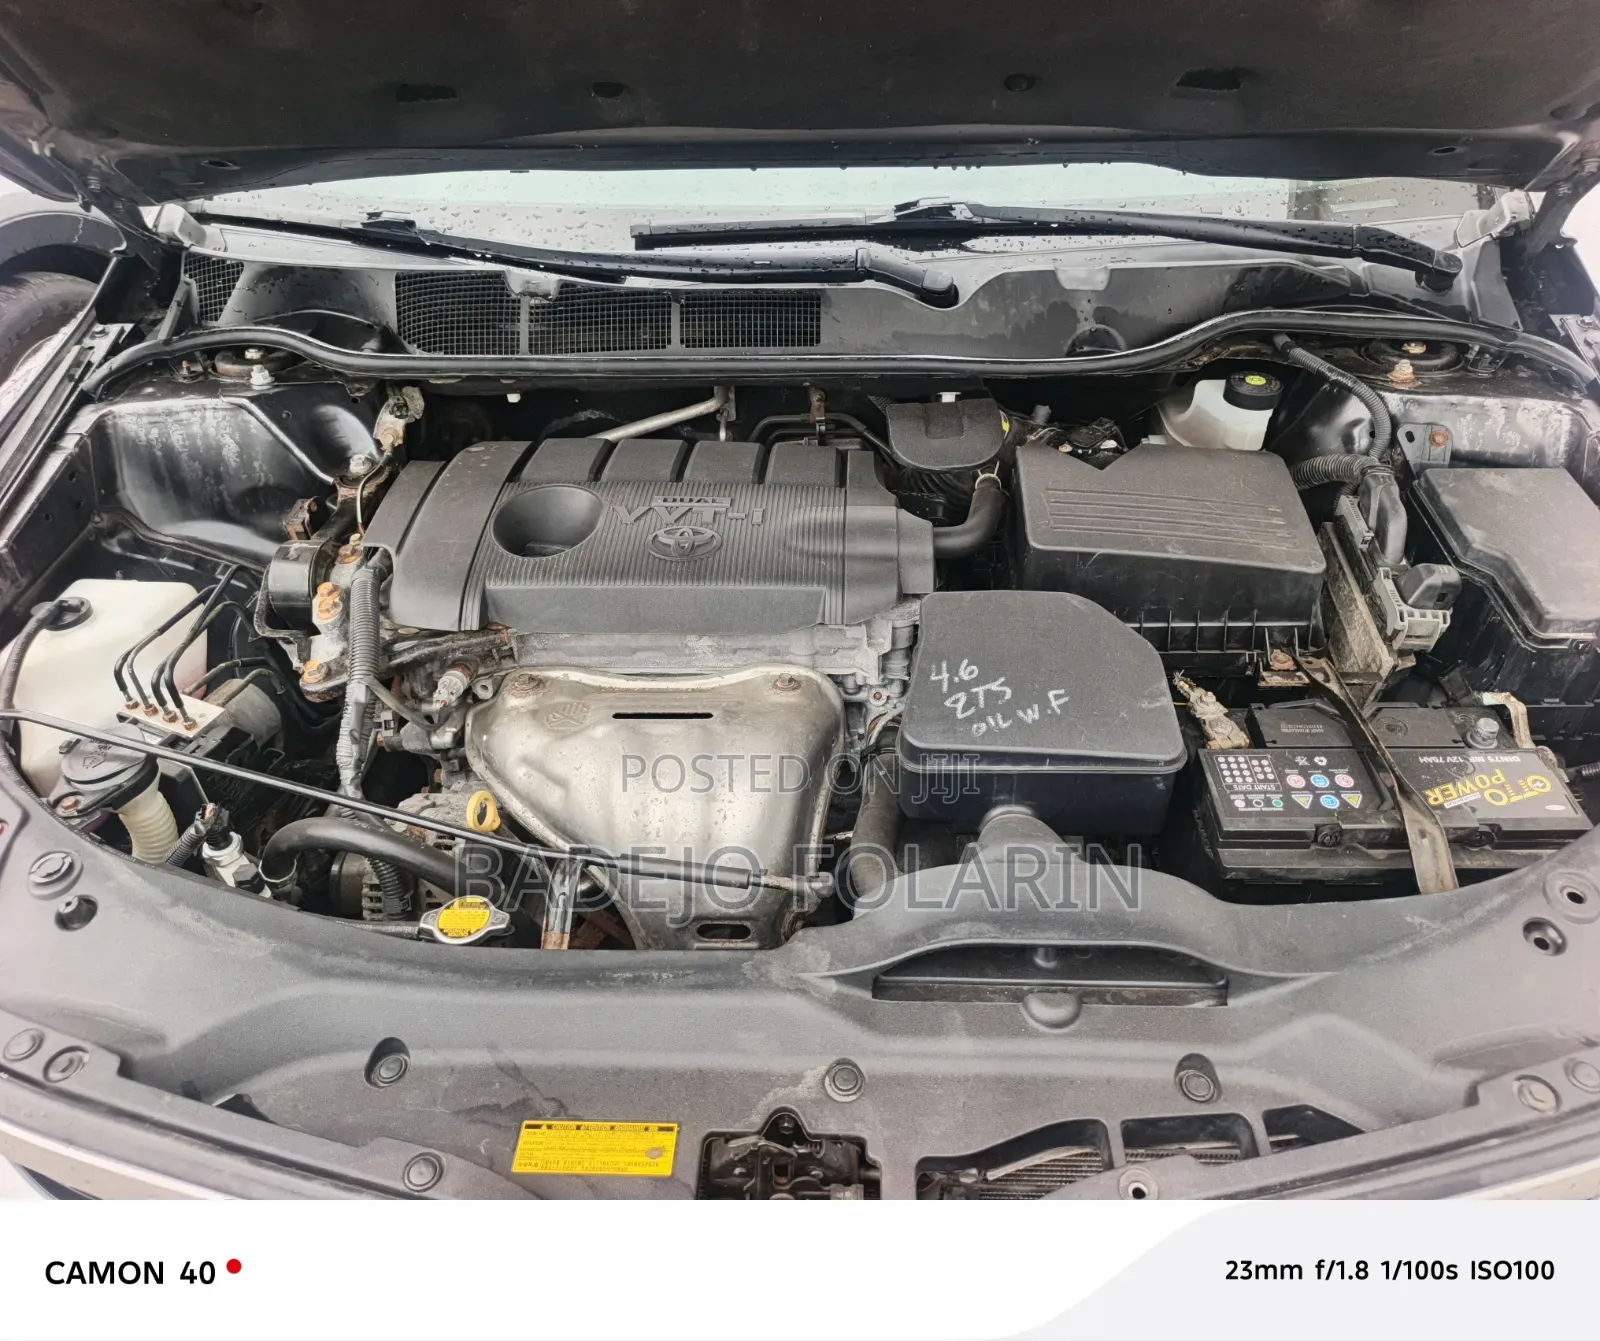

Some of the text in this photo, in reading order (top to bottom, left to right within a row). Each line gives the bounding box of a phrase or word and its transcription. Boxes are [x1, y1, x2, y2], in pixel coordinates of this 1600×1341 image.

[929, 658, 979, 694] 4.6
[971, 712, 1013, 738] OIL
[1423, 768, 1507, 806] POWER
